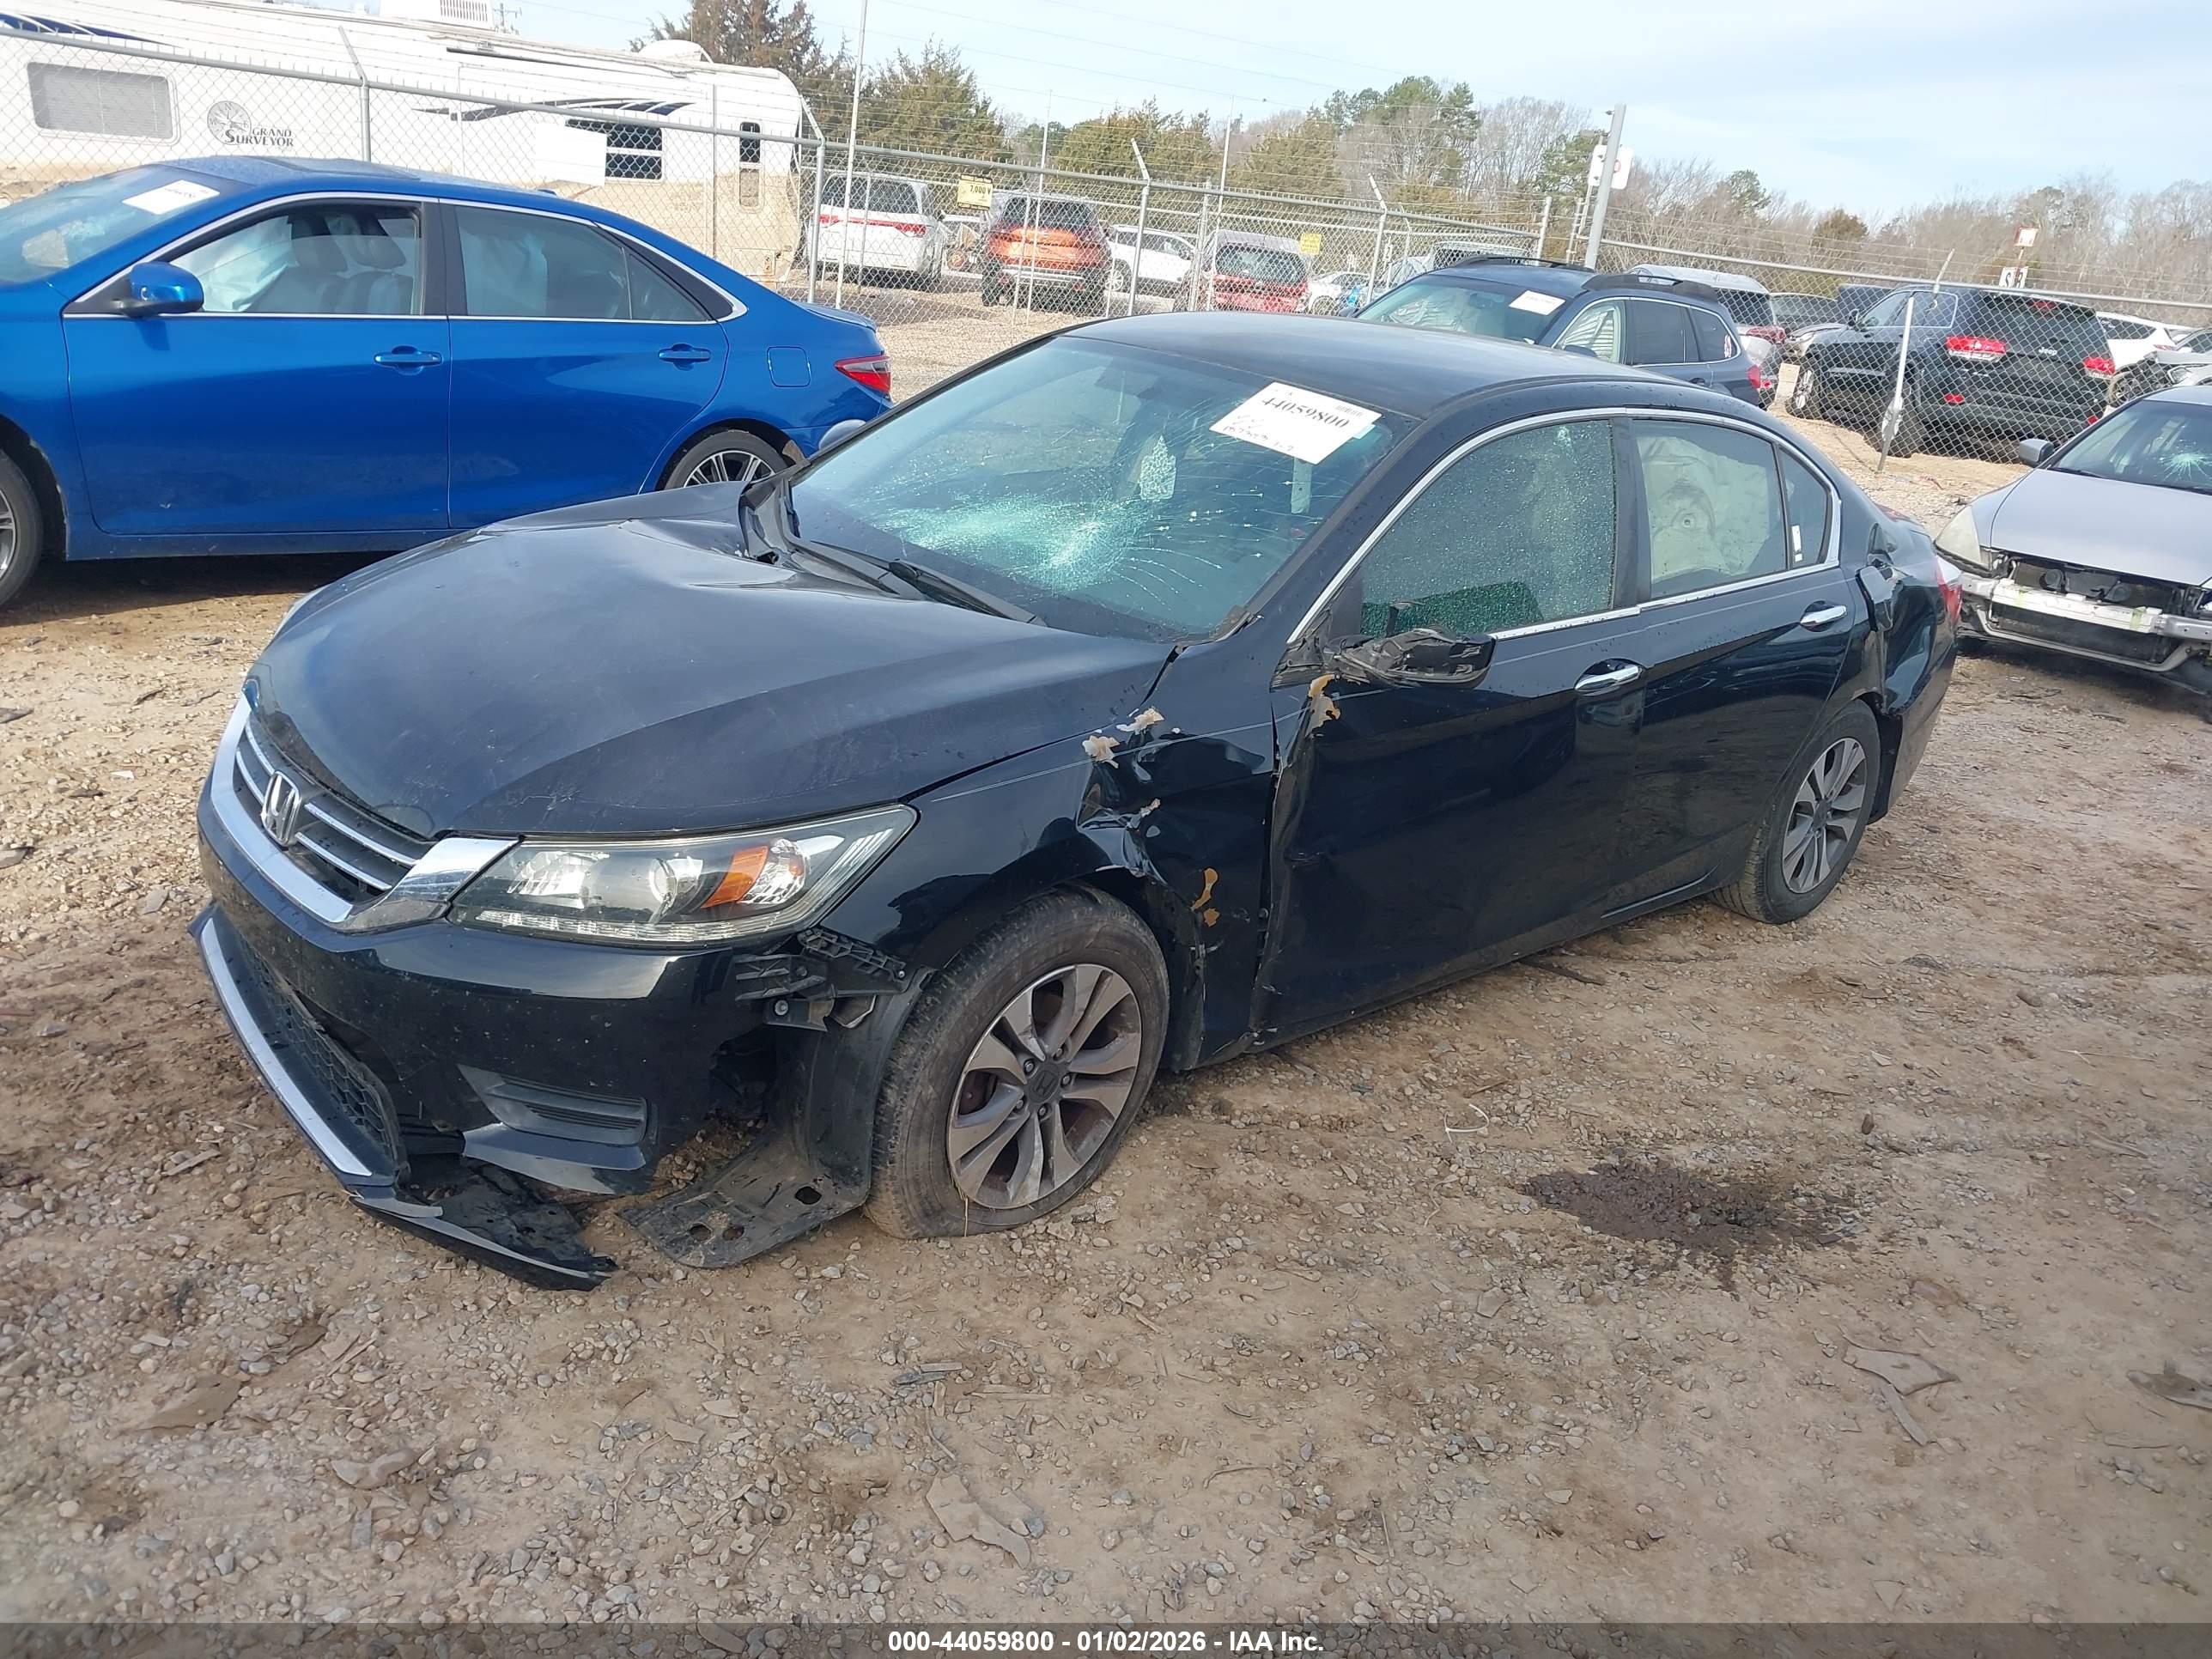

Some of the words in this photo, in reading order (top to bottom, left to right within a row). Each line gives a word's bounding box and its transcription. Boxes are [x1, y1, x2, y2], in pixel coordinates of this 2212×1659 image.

[224, 129, 295, 147] SURVEYOR
[252, 127, 292, 137] GRAND
[2038, 346, 2058, 356] Jeep
[1261, 398, 1351, 428] 44059800
